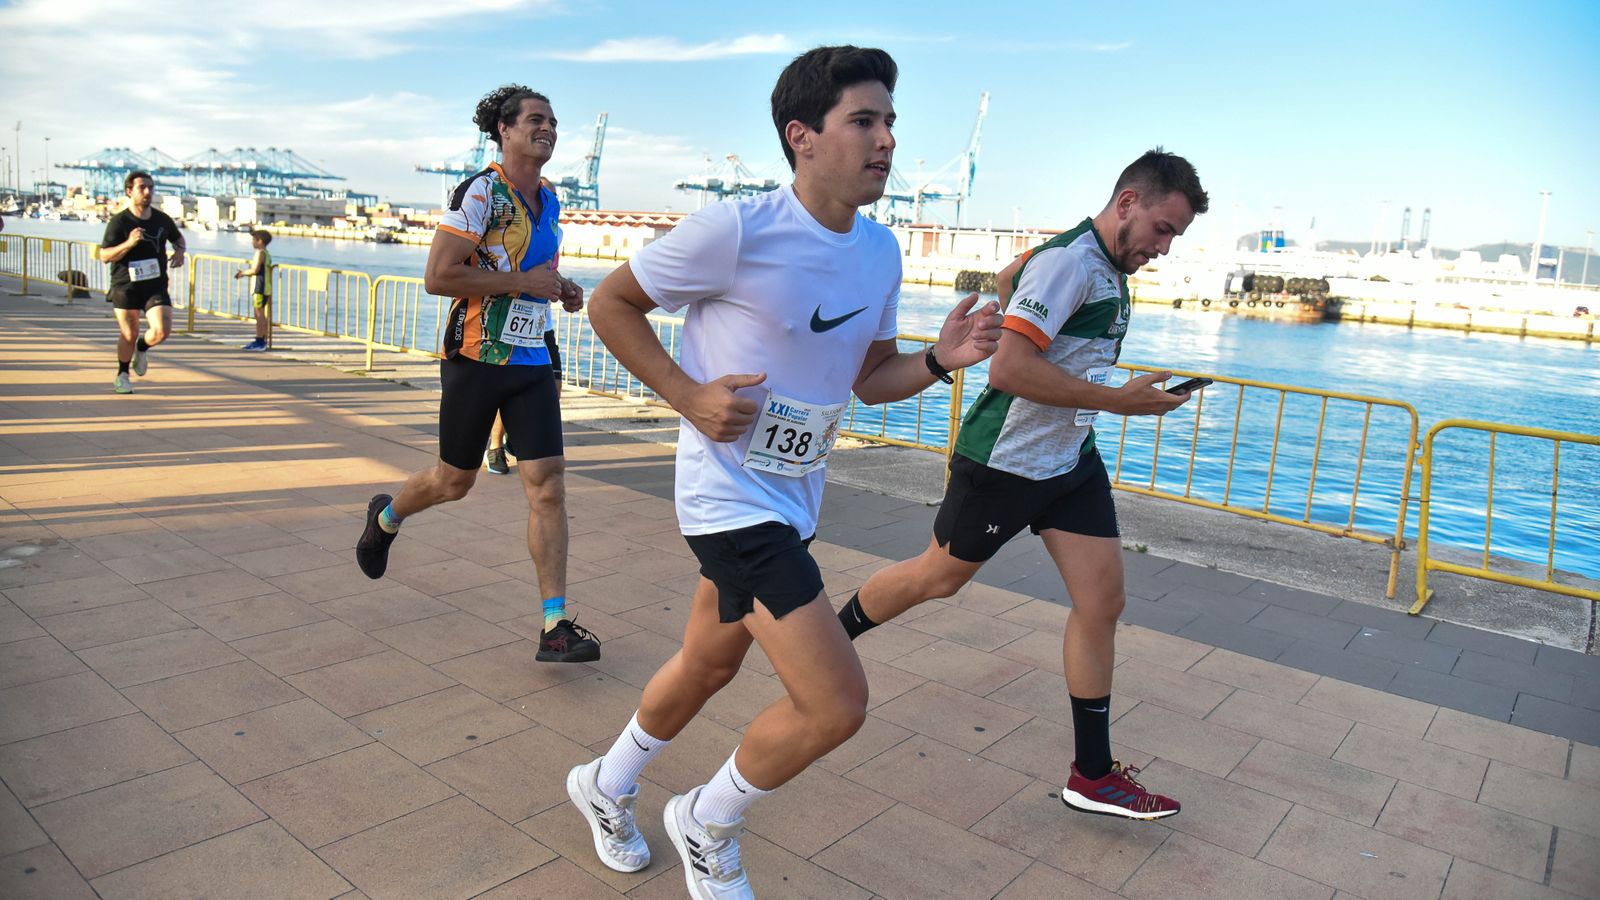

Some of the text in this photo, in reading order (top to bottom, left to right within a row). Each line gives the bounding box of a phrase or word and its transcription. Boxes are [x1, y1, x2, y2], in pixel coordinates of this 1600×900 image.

[1018, 298, 1048, 319] ALMA
[510, 316, 535, 335] 671
[768, 401, 790, 416] XXI
[790, 407, 809, 416] Carrera
[765, 424, 813, 457] 138
